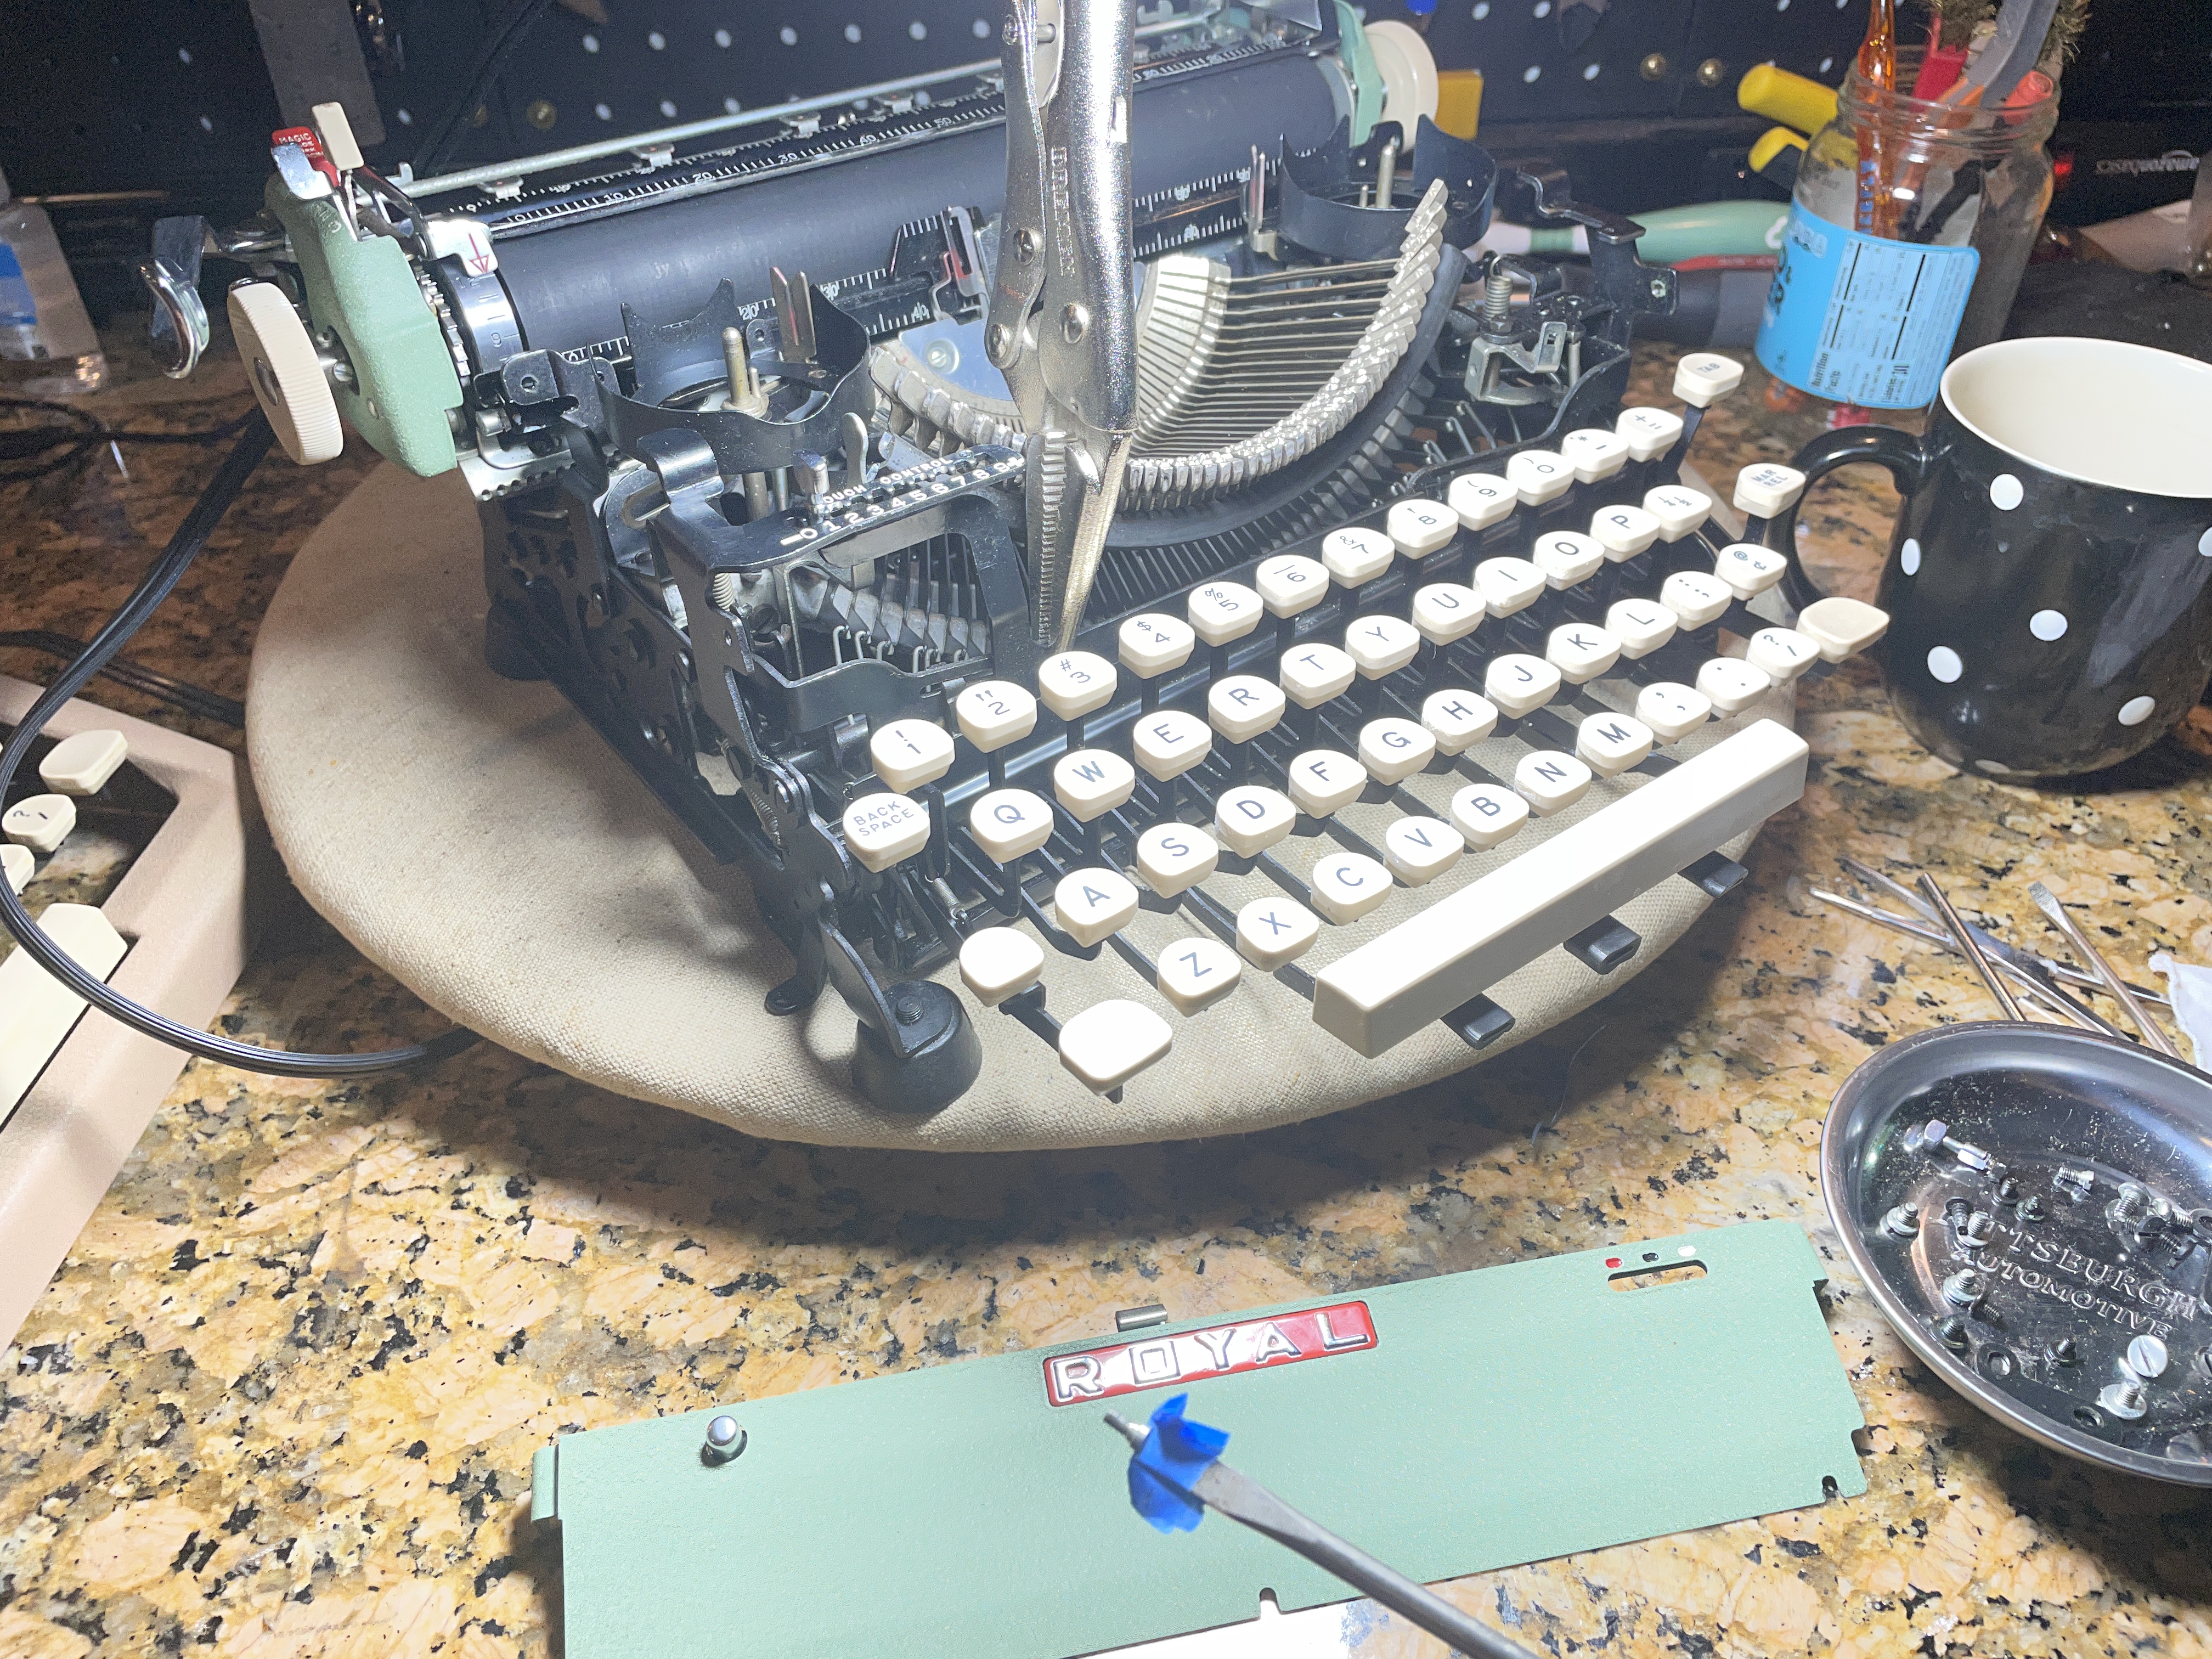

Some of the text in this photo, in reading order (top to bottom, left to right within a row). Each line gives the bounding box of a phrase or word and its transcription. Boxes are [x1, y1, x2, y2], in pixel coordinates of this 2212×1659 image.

[778, 153, 798, 163] 30
[934, 117, 953, 128] 50
[1697, 362, 1720, 373] TAB
[1537, 465, 1555, 473] 0
[822, 456, 953, 504] OUCH CONTROL
[1478, 488, 1497, 497] 9
[1418, 516, 1437, 525] 8
[1610, 515, 1630, 529] P
[1351, 544, 1369, 554] 7
[1554, 541, 1580, 555] O
[1286, 572, 1306, 582] 6
[1218, 599, 1239, 611] 5
[1431, 593, 1460, 609] U
[1626, 613, 1656, 625] L
[1137, 620, 1171, 643] $ 4
[1365, 626, 1389, 642] Y
[1566, 633, 1599, 651] K
[1059, 658, 1091, 684] # 3
[1299, 654, 1324, 670] T
[1514, 665, 1533, 682] J
[1228, 688, 1260, 706] R
[988, 701, 1011, 715] 2
[1441, 700, 1474, 720] H
[1153, 723, 1184, 744] E
[1381, 732, 1412, 748] G
[1596, 723, 1632, 744] M
[907, 743, 921, 754] 1
[1071, 760, 1105, 783] W
[1308, 761, 1330, 782] F
[1534, 761, 1567, 783] N
[853, 800, 901, 826] BACK
[994, 804, 1026, 824] Q
[1235, 800, 1266, 820] D
[1470, 797, 1501, 817] B
[857, 809, 915, 837] SPACE
[1161, 837, 1189, 857] S
[1404, 828, 1433, 848] V
[1336, 867, 1364, 887] C
[1082, 886, 1111, 907] A
[1258, 912, 1292, 935] X
[1179, 951, 1212, 978] Z
[1984, 1219, 2197, 1322] TTSBURGH
[1052, 1312, 1370, 1403] ROYAL
